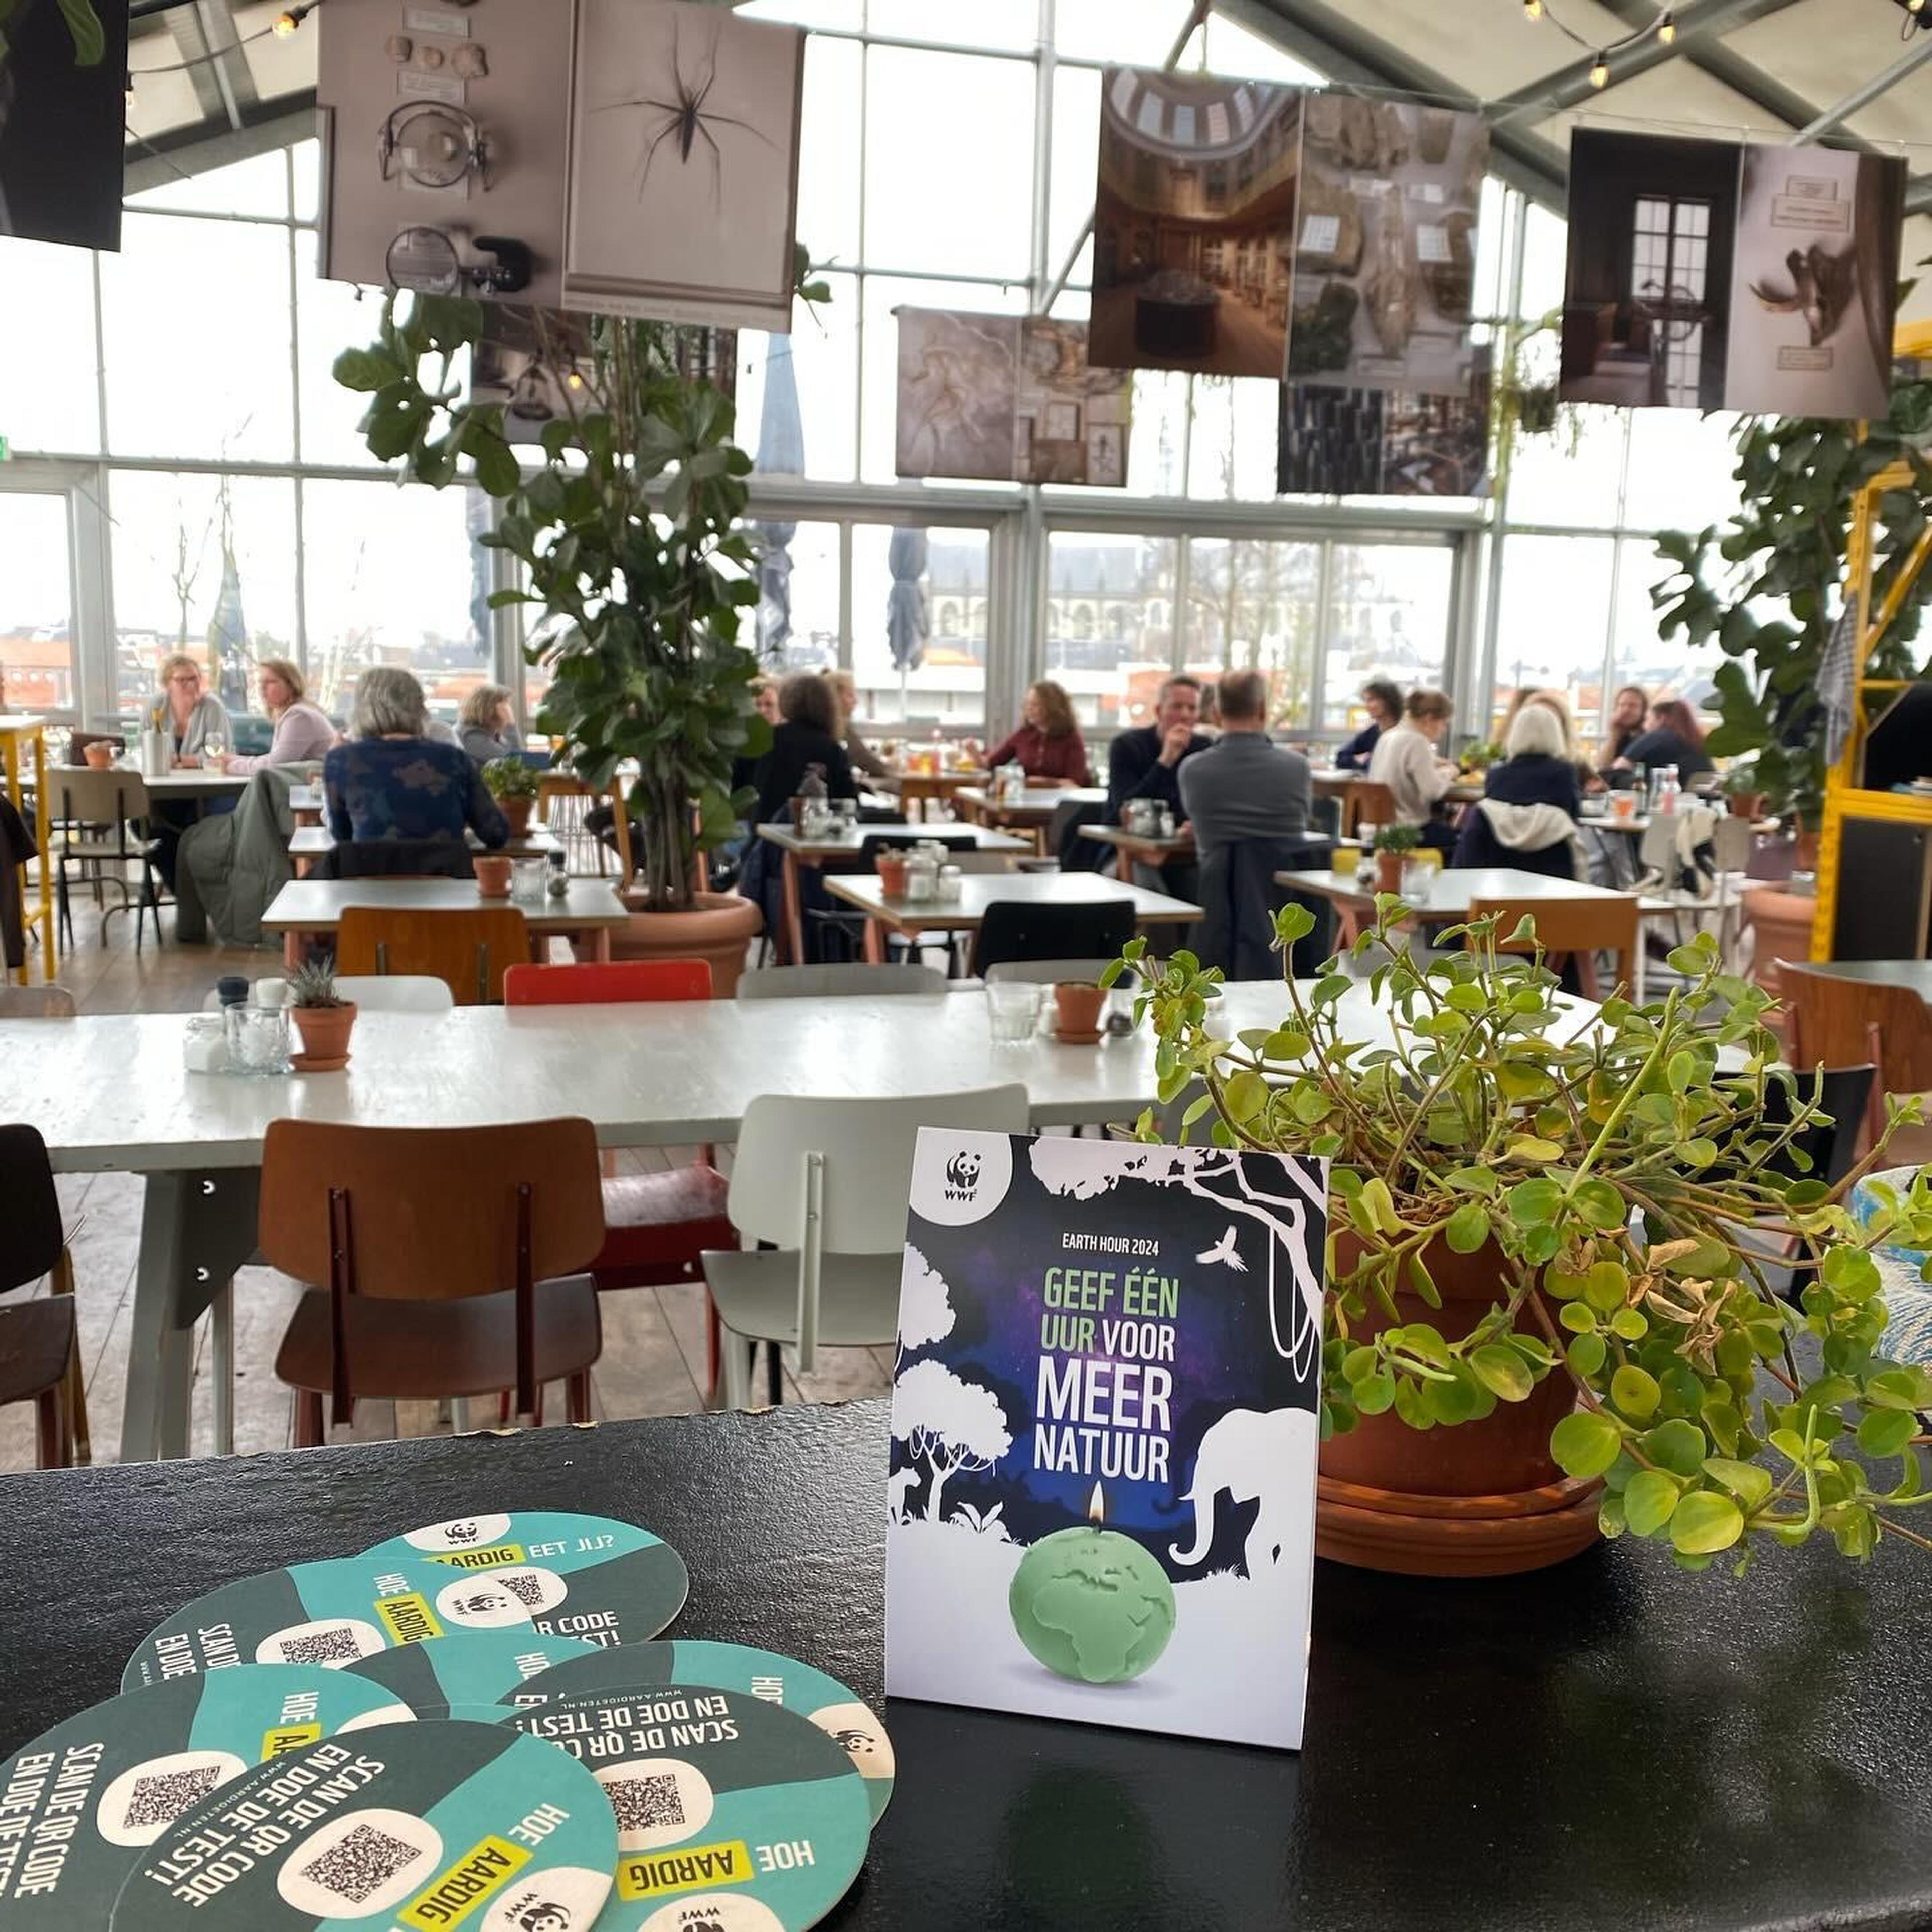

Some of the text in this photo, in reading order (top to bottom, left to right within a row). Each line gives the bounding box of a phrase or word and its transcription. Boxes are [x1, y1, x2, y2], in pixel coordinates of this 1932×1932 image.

[945, 1189, 977, 1201] WWF
[1062, 1233, 1159, 1257] EARTH HOUR 2024
[1044, 1266, 1179, 1319] GEEF ÉÉN
[1040, 1313, 1176, 1362] UUR VOOR
[1036, 1355, 1173, 1432] MEER
[1034, 1423, 1170, 1483] NATUUR
[436, 1535, 614, 1568] ARDIG EET JIJ?
[373, 1572, 434, 1642] HOE AARDIG
[537, 1611, 620, 1635] R CODE
[155, 1633, 197, 1680] EN DOE
[198, 1623, 237, 1657] SCAN
[280, 1691, 320, 1724] HOE
[598, 1707, 632, 1730] DE
[638, 1702, 690, 1725] DOE
[694, 1695, 730, 1718] EN
[588, 1731, 625, 1758] QR
[633, 1727, 666, 1752] DE
[671, 1719, 739, 1747] SCAN
[13, 1752, 56, 1779] EN
[303, 1743, 352, 1772] EN
[0, 1777, 46, 1817] DOE
[255, 1765, 320, 1807] DOE
[14, 1742, 105, 1899] SCAN DE QR CODE
[172, 1755, 386, 1908] SCAN DE QR CODE
[219, 1800, 271, 1833] DE
[144, 1828, 237, 1887] TEST!
[415, 1802, 570, 1925] HOE AARDIG
[629, 1840, 816, 1891] HOE AARDIG
[504, 1892, 539, 1922] WWF
[681, 1905, 720, 1921] WWF
